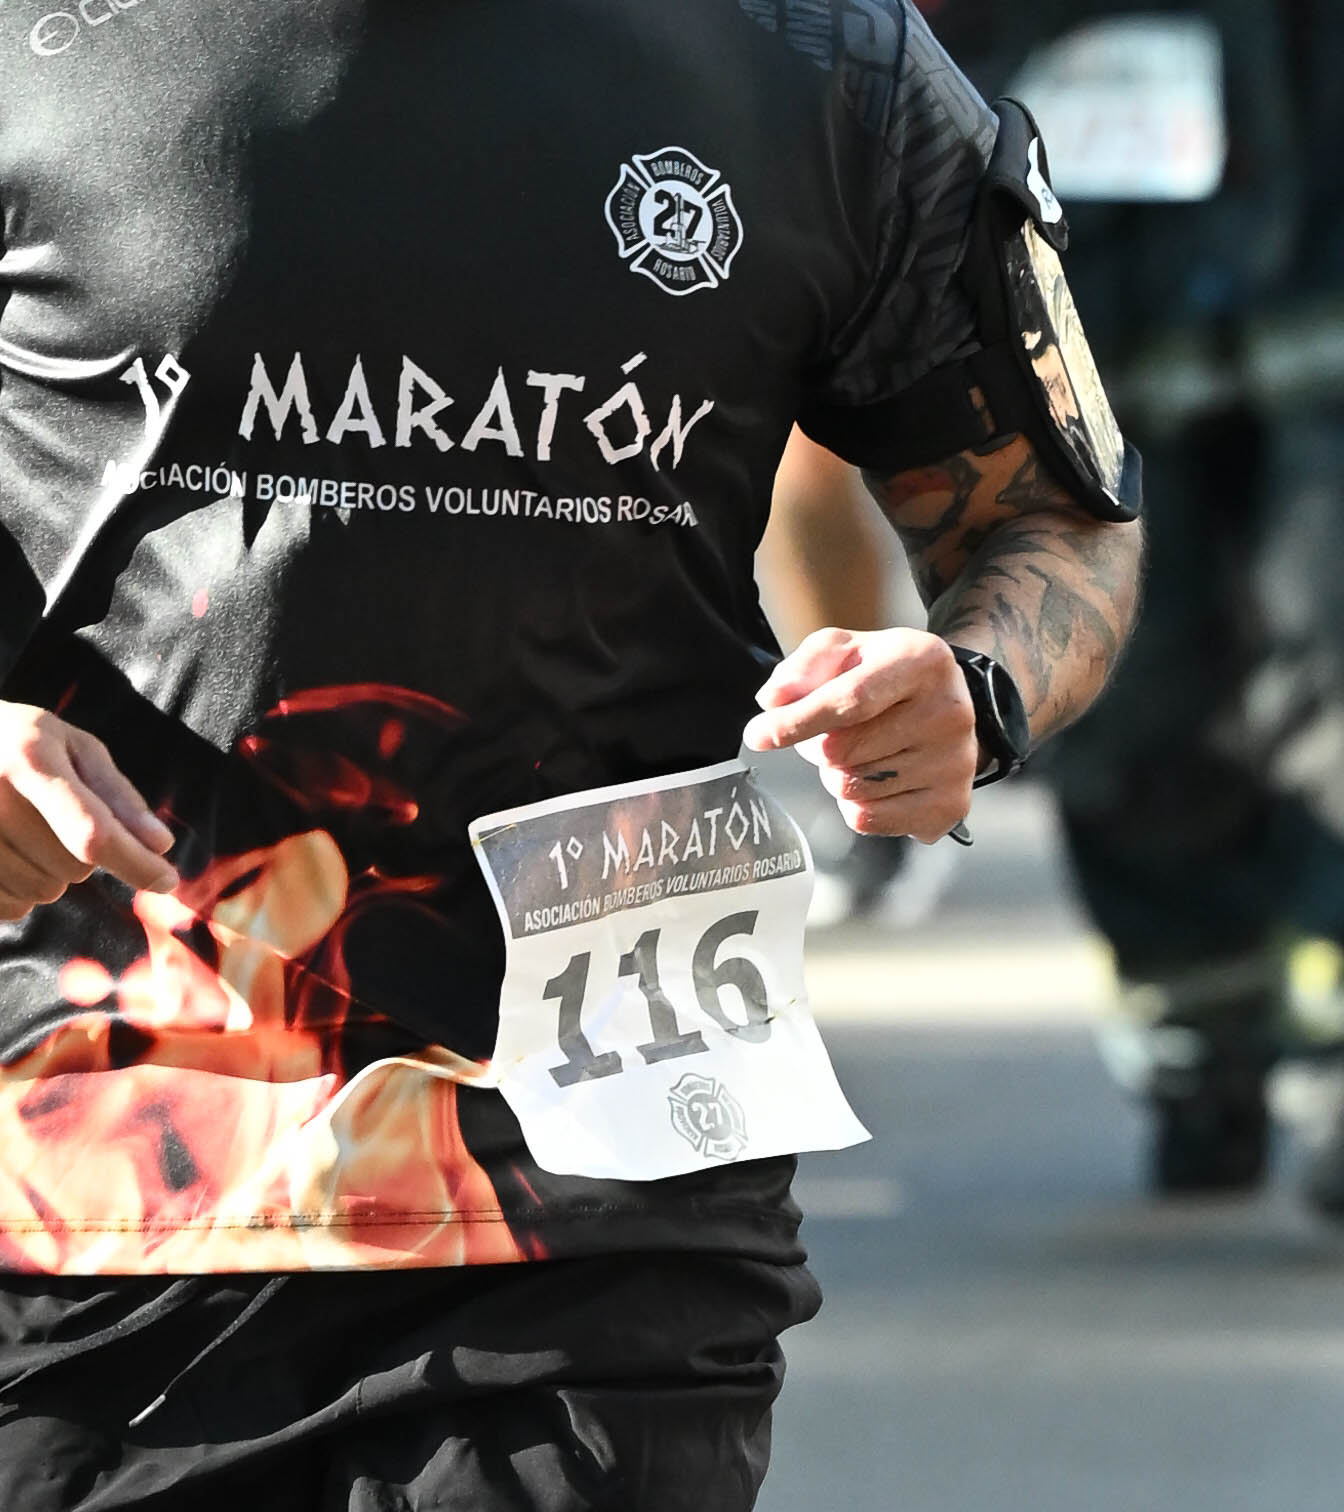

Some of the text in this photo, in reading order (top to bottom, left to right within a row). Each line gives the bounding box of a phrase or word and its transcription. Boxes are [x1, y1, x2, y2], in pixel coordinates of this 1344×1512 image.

[650, 160, 705, 185] BOMBEROS
[653, 189, 703, 241] 27
[653, 258, 697, 281] ROSARIO
[239, 351, 714, 472] MARATÓN
[256, 474, 416, 512] BOMBEROS
[425, 486, 612, 524] VOLUNTARIOS
[601, 787, 772, 879] MARATÓN
[523, 850, 802, 932] ASOCIACIÓN BOMBEROS VOLUNTARIOS ROSARIO
[542, 910, 772, 1088] 116
